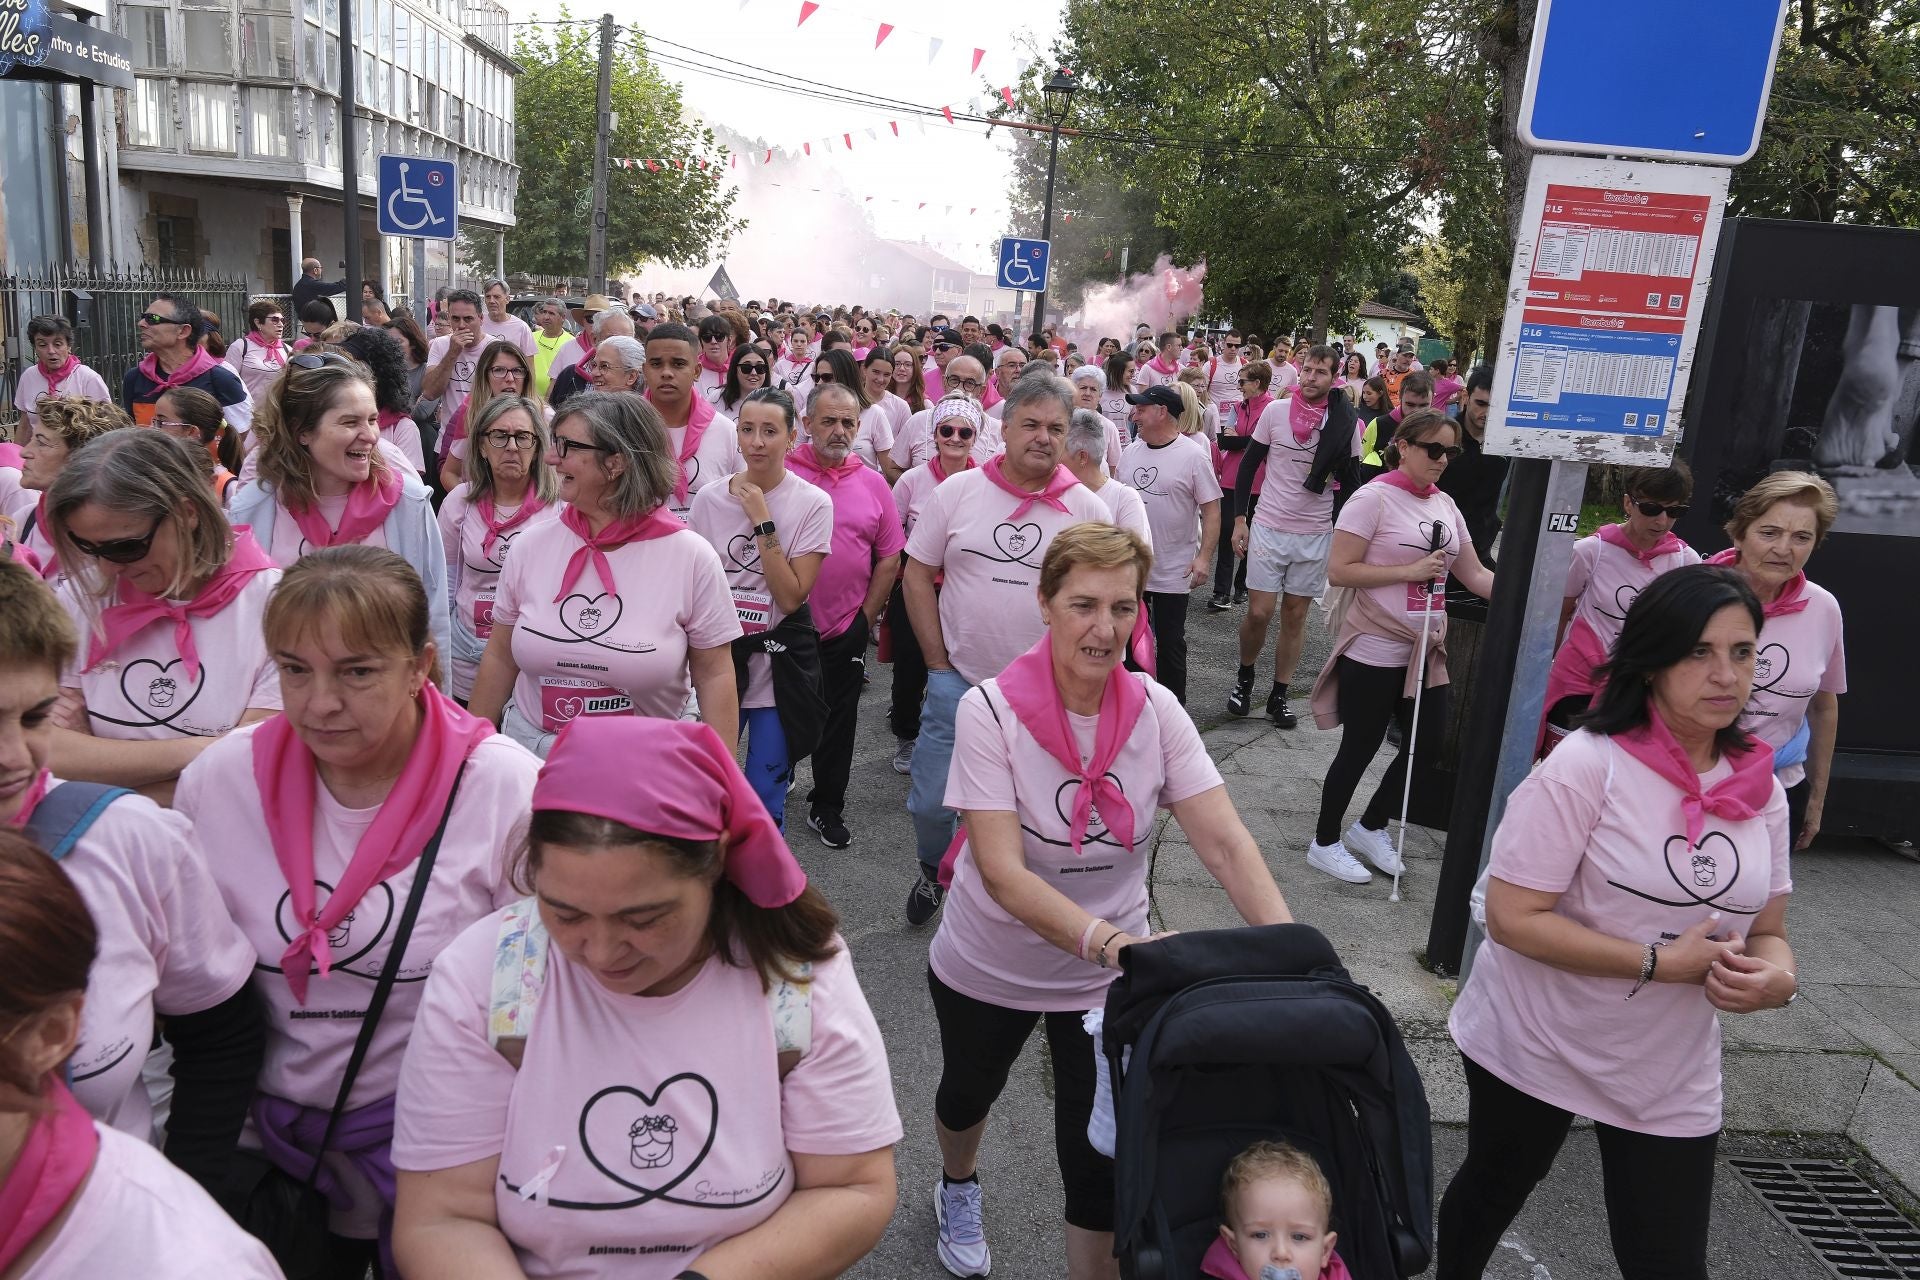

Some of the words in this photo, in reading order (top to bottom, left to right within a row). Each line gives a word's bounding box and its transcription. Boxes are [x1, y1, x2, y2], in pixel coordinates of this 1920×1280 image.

[76, 41, 88, 58] de
[92, 45, 131, 71] Estudios
[1552, 206, 1563, 214] L5
[1530, 329, 1542, 337] L6
[1549, 514, 1578, 531] FILS
[544, 678, 578, 687] DORSAL
[588, 697, 631, 711] 0985
[694, 1180, 753, 1205] Siempre
[588, 1246, 636, 1256] Anjanas
